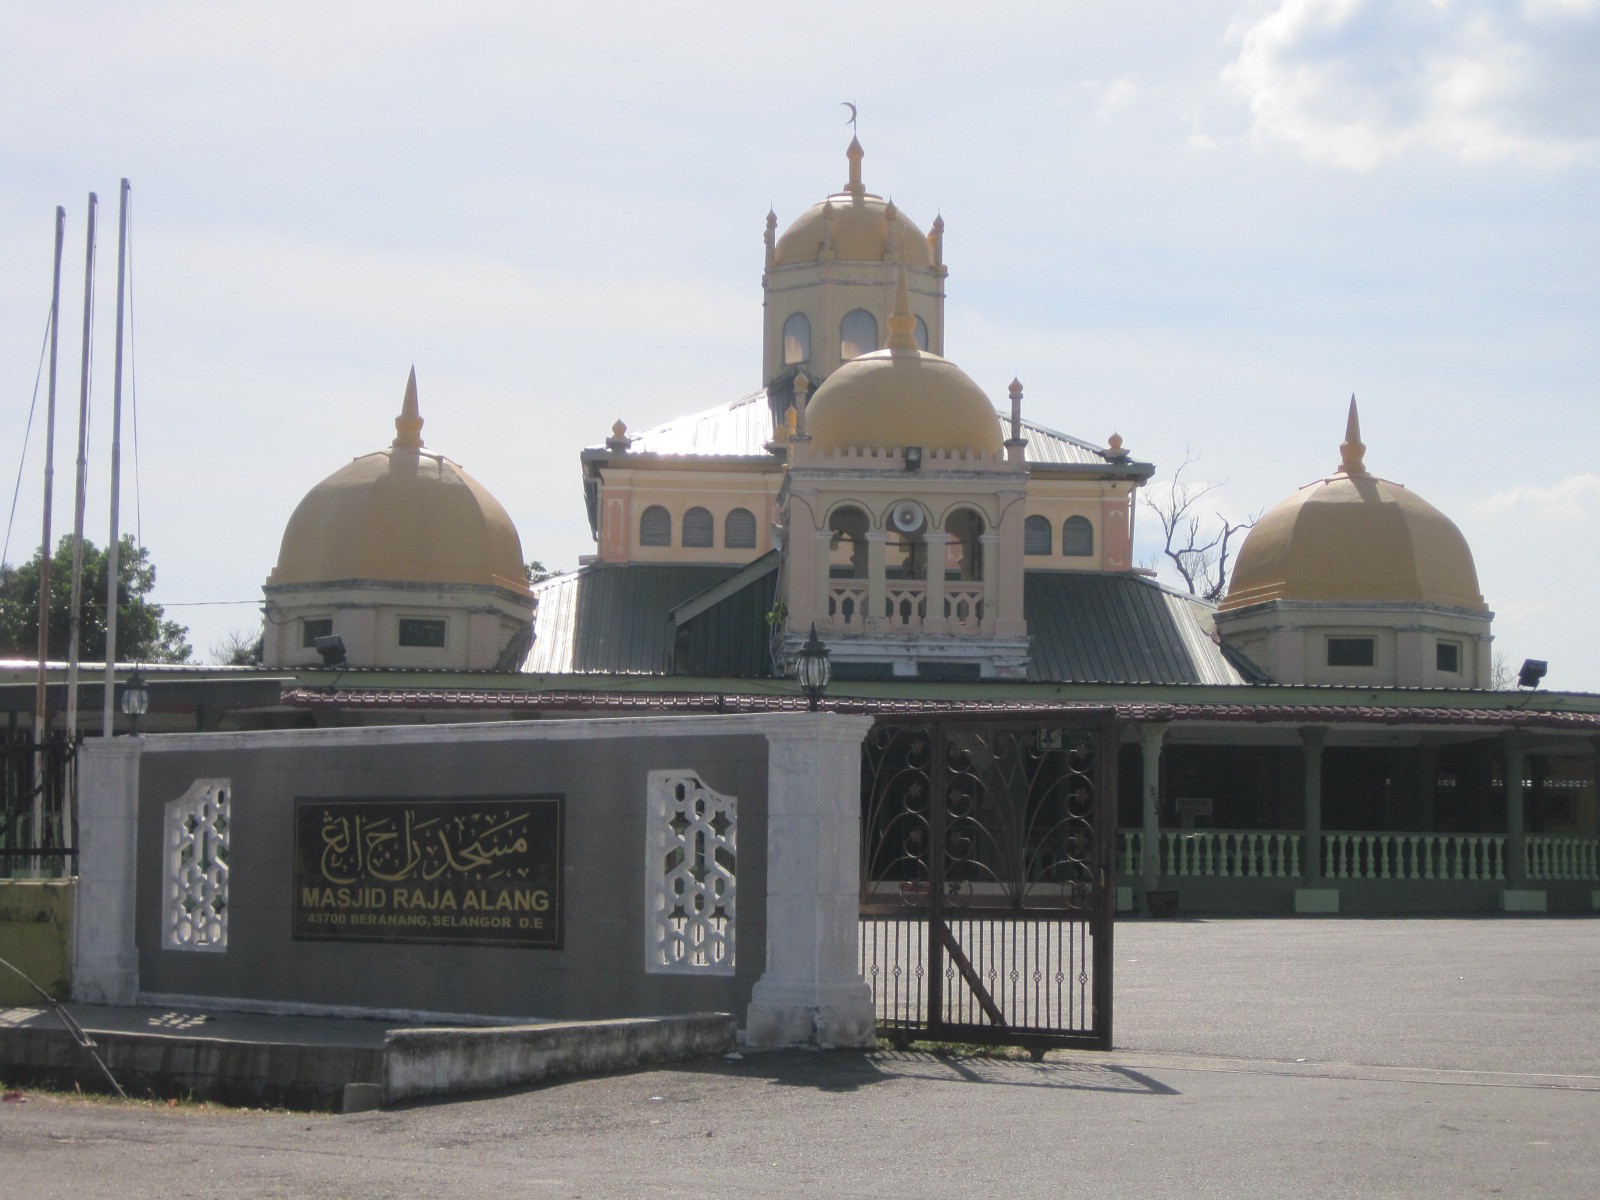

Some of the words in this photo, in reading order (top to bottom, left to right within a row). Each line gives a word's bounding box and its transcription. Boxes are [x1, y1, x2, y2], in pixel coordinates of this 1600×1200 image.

[302, 887, 387, 908] MASJID
[392, 888, 458, 910] RAJA
[462, 889, 550, 911] ALANG
[306, 913, 347, 925] 43700
[432, 916, 512, 929] SELANGOR
[518, 917, 544, 930] D.E
